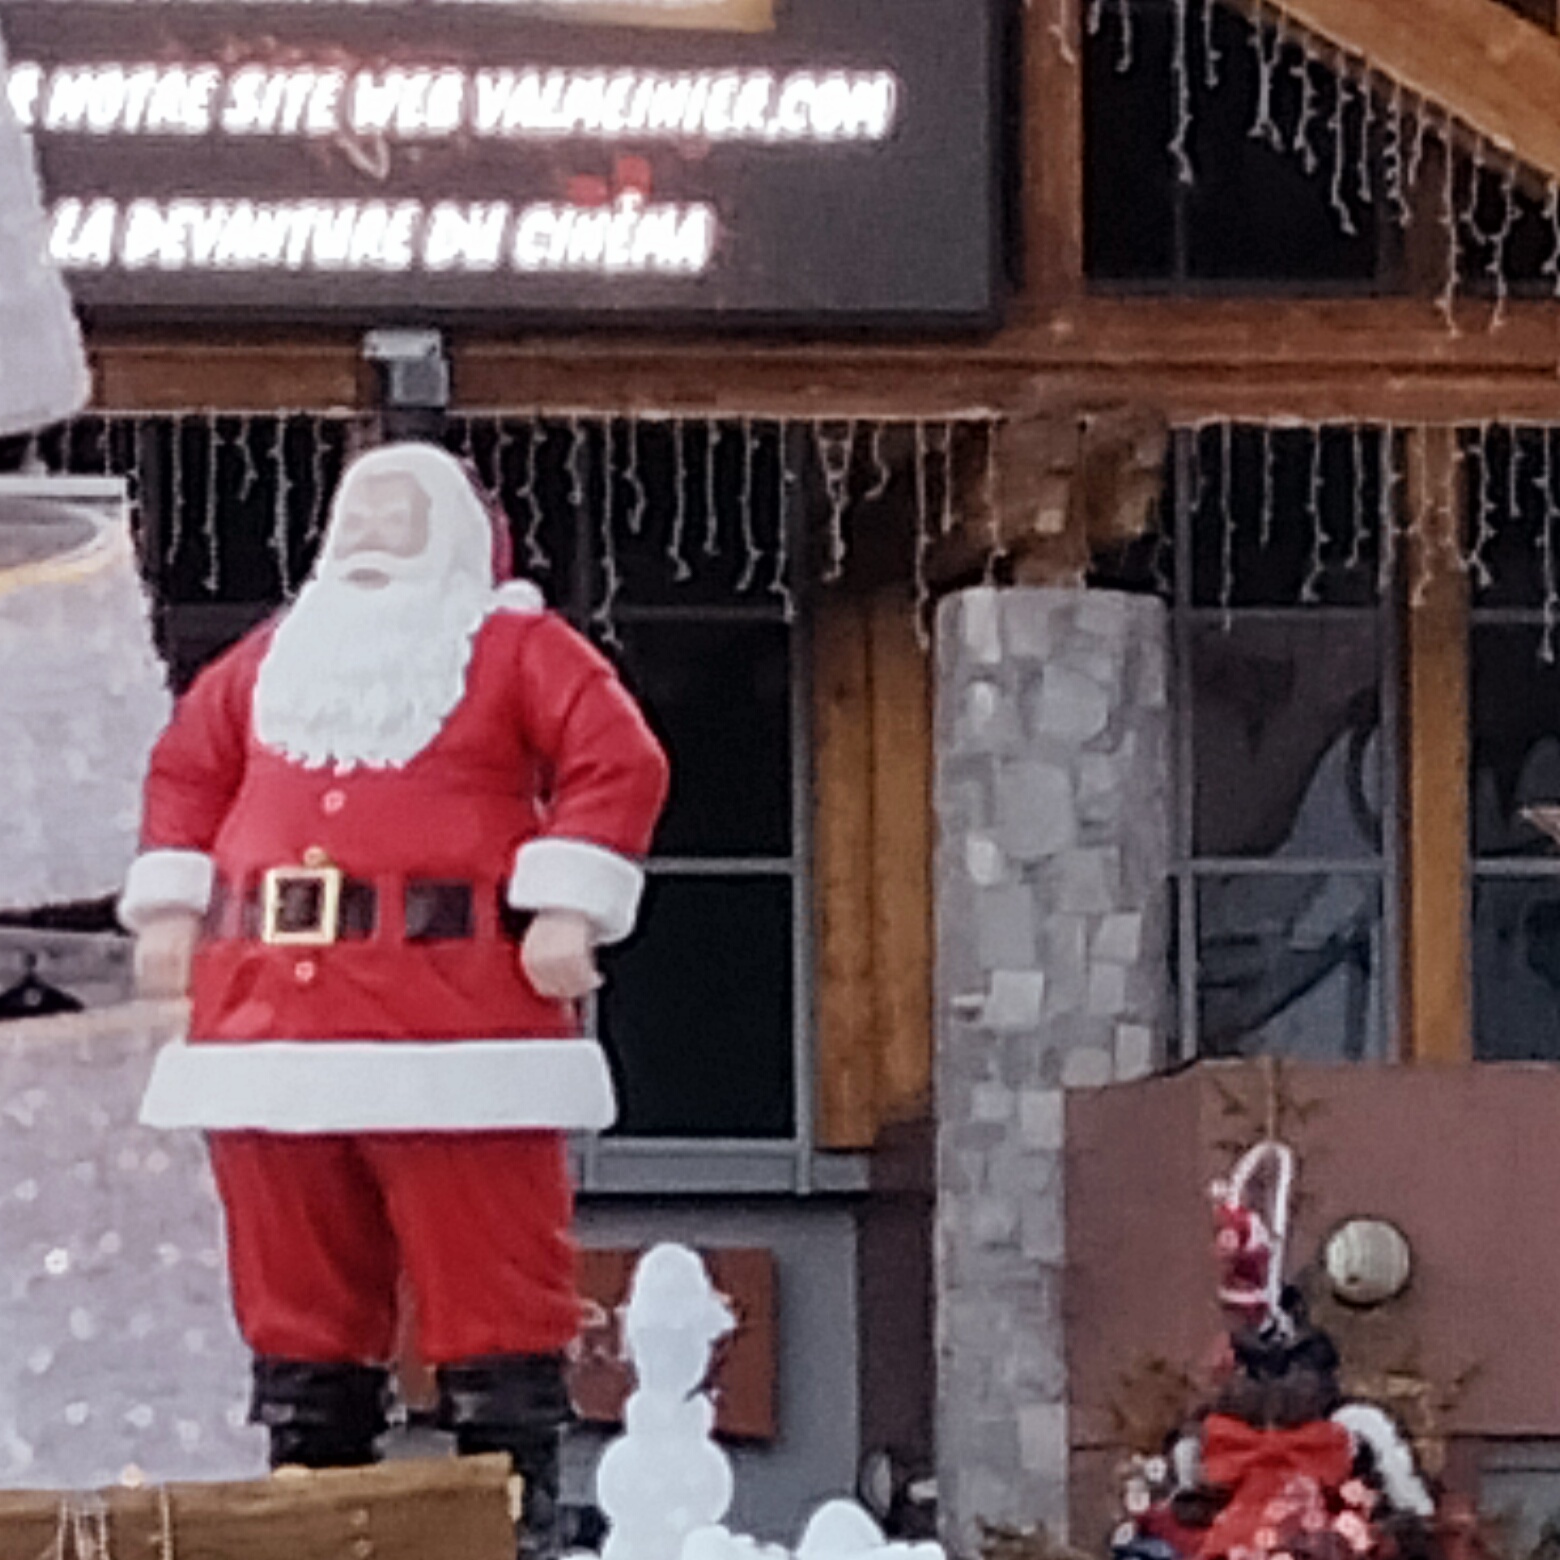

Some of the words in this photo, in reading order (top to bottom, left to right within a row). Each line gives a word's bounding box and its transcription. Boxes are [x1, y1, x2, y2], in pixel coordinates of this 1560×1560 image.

[43, 62, 218, 135] NOTRE
[221, 66, 344, 135] SITE
[349, 67, 466, 136] WEB
[48, 199, 118, 267] LA
[122, 199, 423, 270] DEVANTURE
[425, 200, 510, 269] DU
[513, 188, 715, 271] CINÉMA
